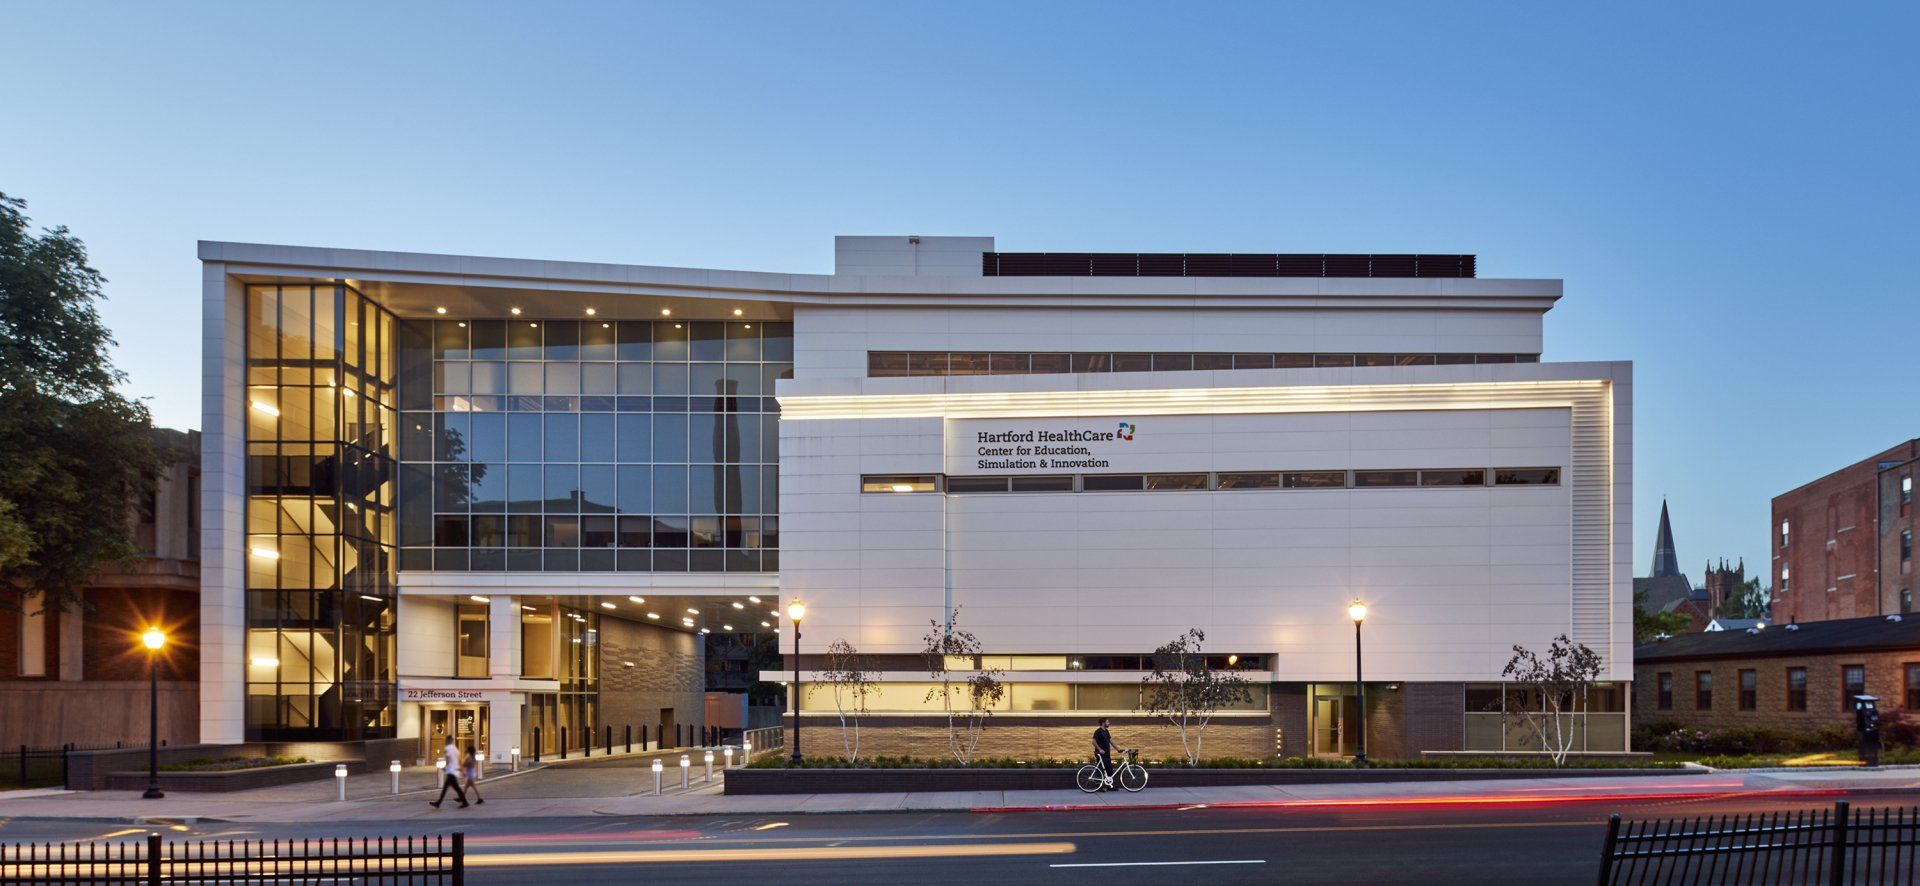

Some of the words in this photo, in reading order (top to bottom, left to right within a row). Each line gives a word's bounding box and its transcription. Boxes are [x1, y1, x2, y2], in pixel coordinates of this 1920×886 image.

[977, 430, 1034, 443] Hartford
[1038, 429, 1114, 442] HealthCare
[977, 446, 1015, 456] Center
[1016, 445, 1032, 456] for
[1034, 445, 1091, 457] Education,
[977, 459, 1036, 469] Simulation
[1039, 459, 1048, 468] &
[1051, 458, 1109, 468] Innovation
[408, 690, 418, 698] 22
[420, 690, 456, 699] Jefferson
[458, 690, 482, 698] Street
